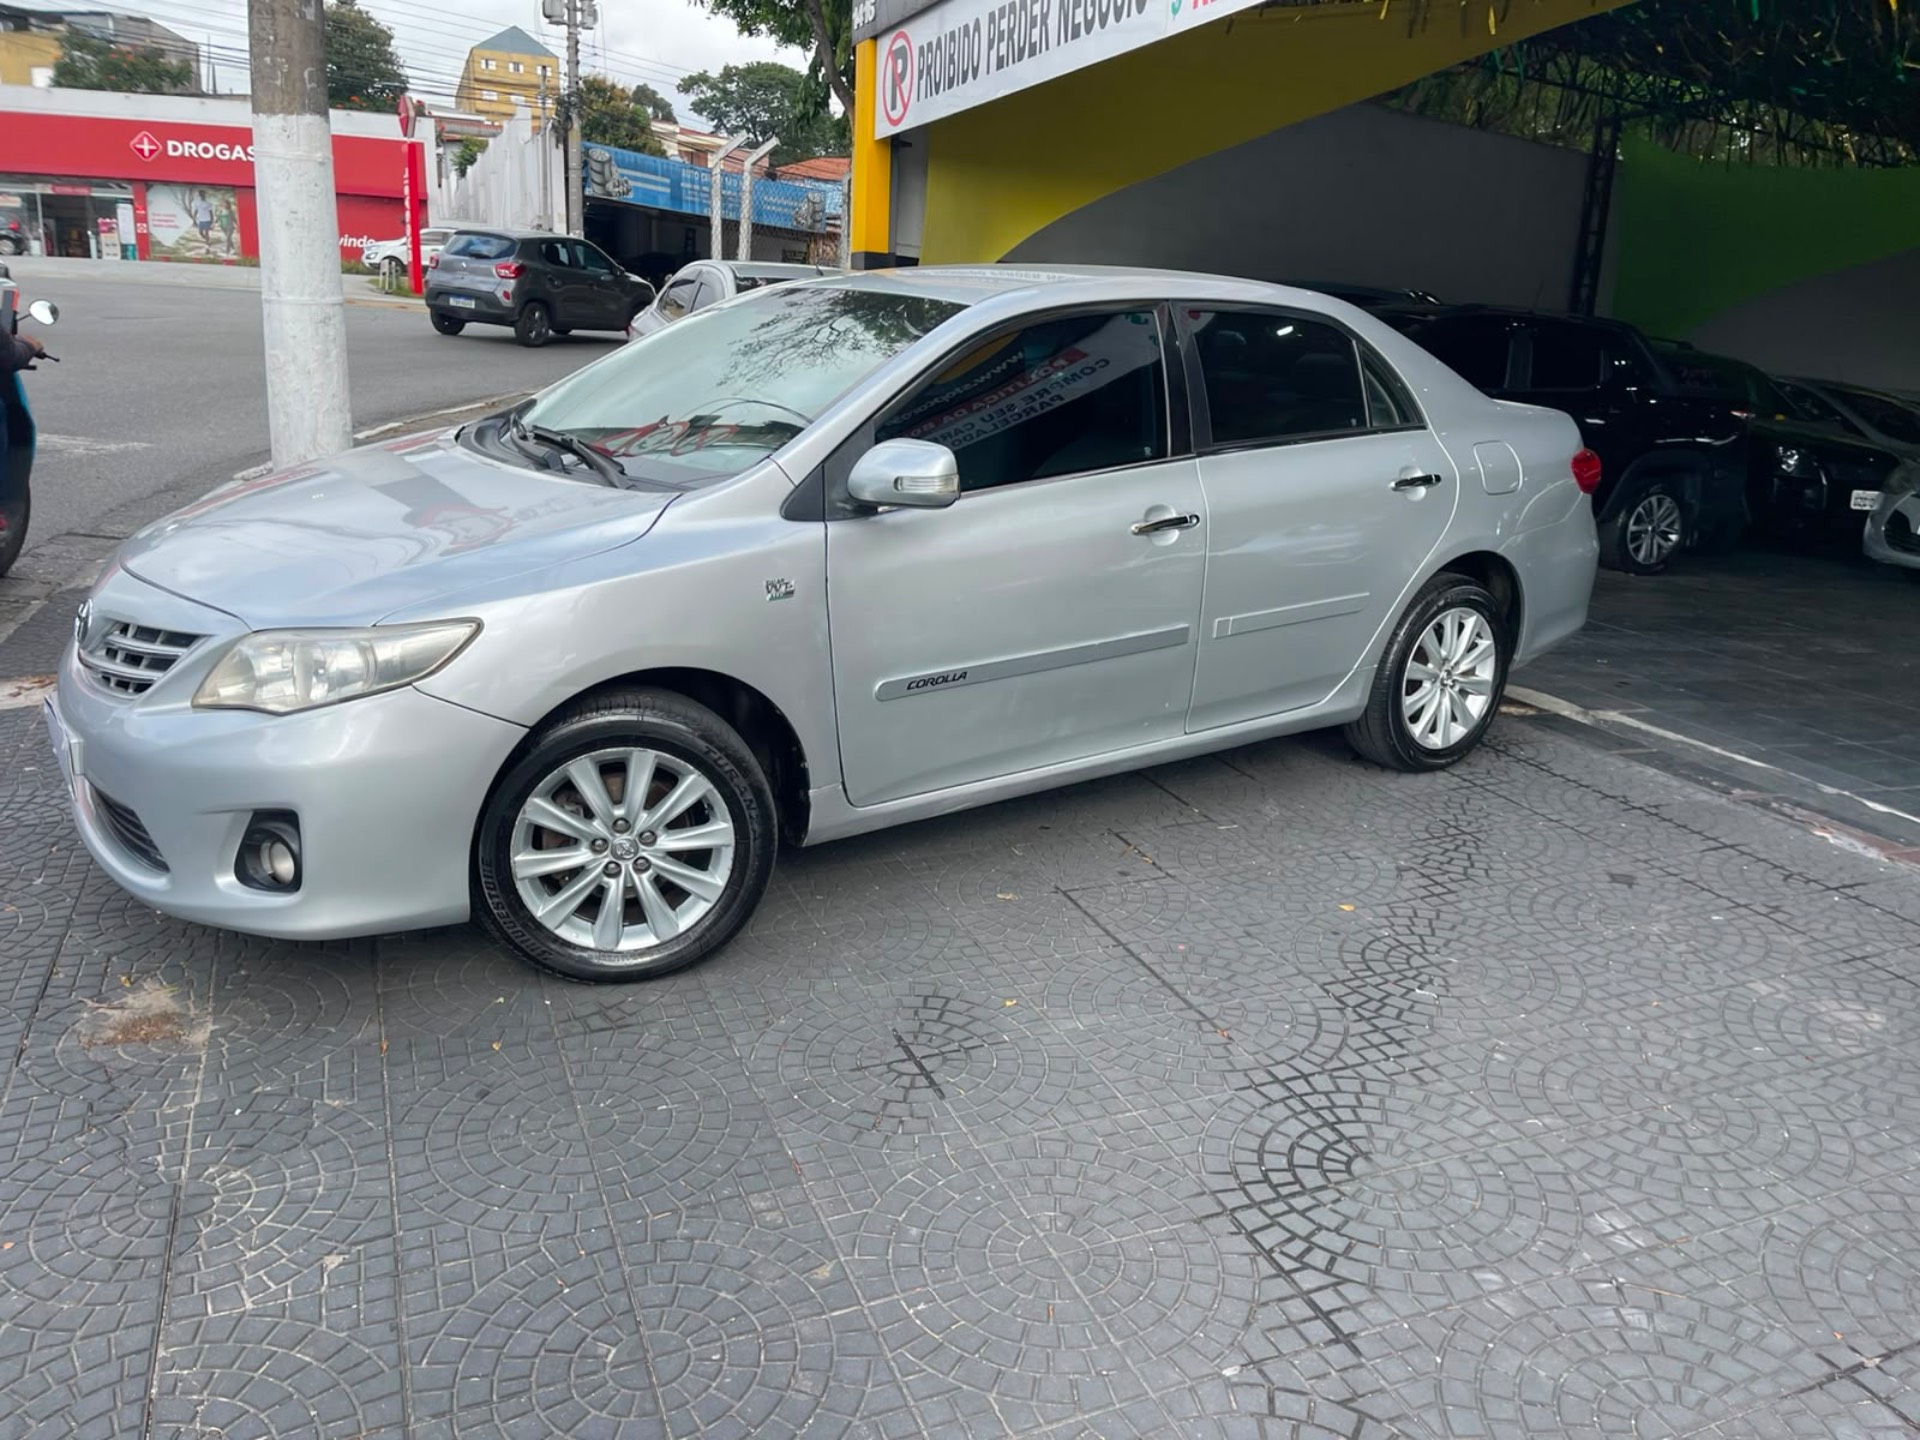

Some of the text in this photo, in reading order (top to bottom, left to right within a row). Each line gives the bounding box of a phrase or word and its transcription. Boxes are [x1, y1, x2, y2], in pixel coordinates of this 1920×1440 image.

[917, 17, 981, 102] PROIBIDO
[986, 0, 1051, 75] PERDER
[1057, 0, 1147, 47] NEGO
[166, 139, 255, 162] DROGAS
[906, 671, 968, 691] COROLLA
